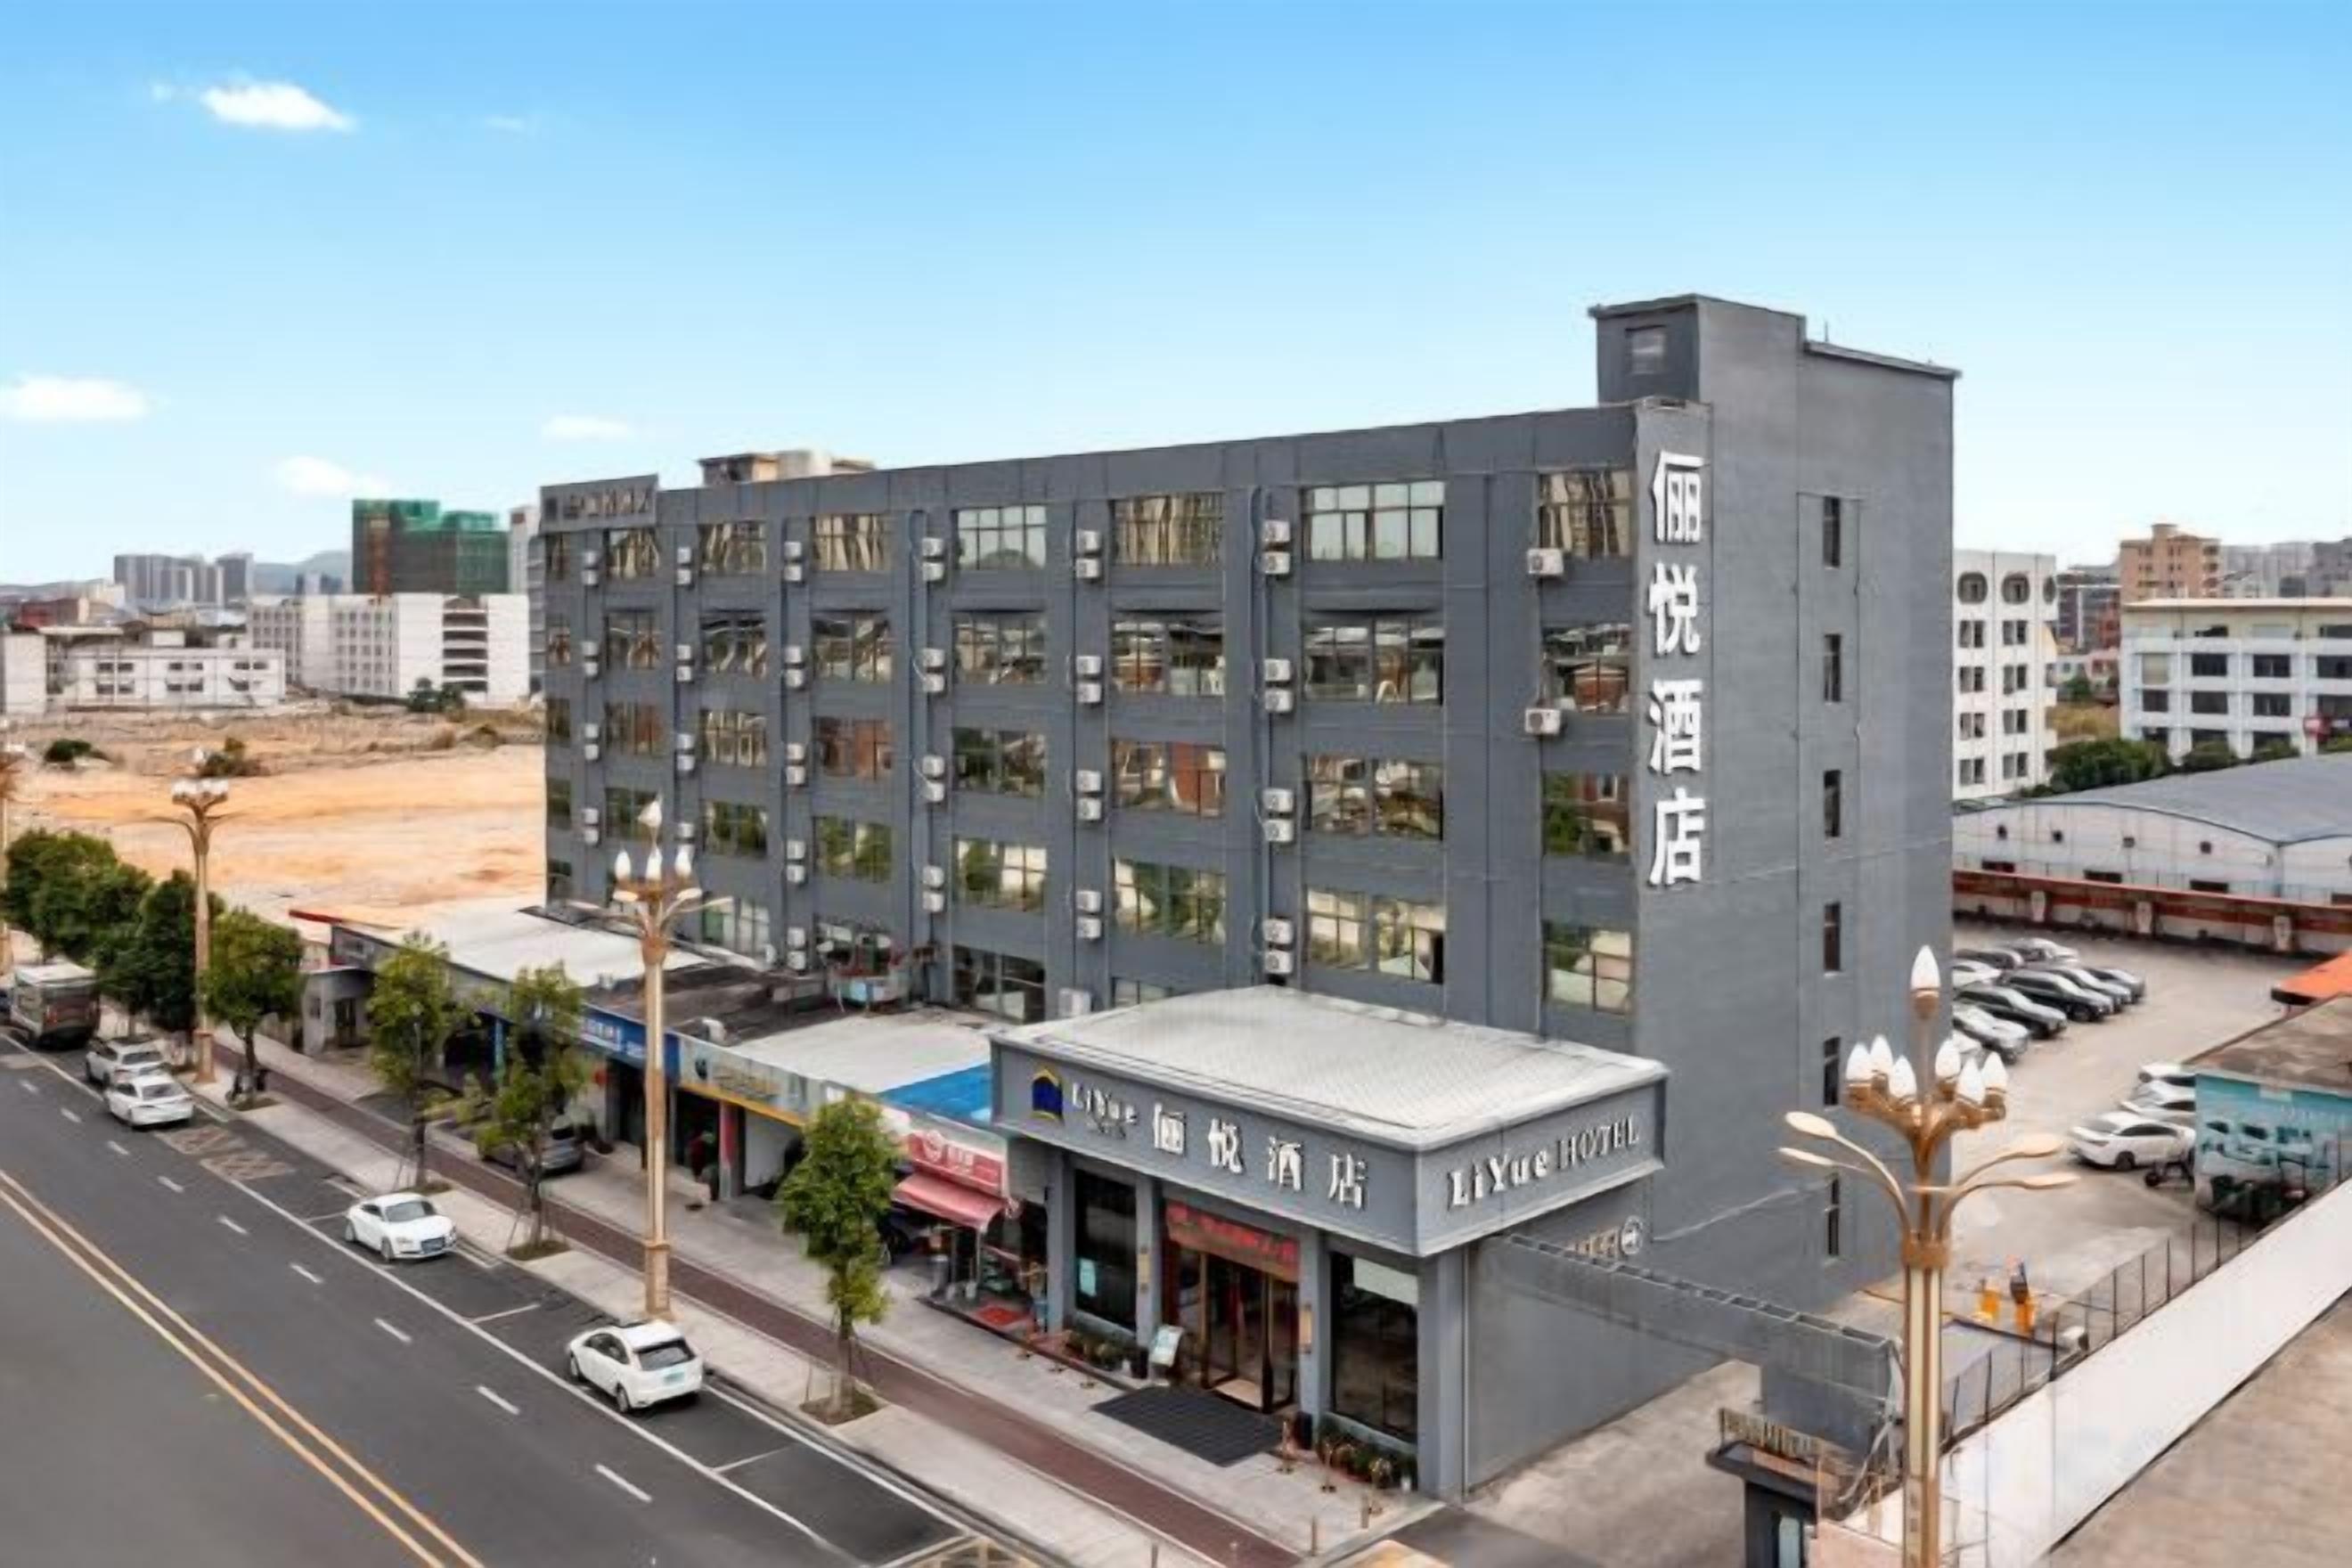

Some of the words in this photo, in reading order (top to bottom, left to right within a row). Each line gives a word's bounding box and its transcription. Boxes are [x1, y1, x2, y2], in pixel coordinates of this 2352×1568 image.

[1649, 449, 1707, 886] 俪悦酒店
[1153, 1103, 1367, 1209] 俪悦酒店
[1448, 1147, 1549, 1207] LiYue
[1558, 1114, 1640, 1169] HOTEL
